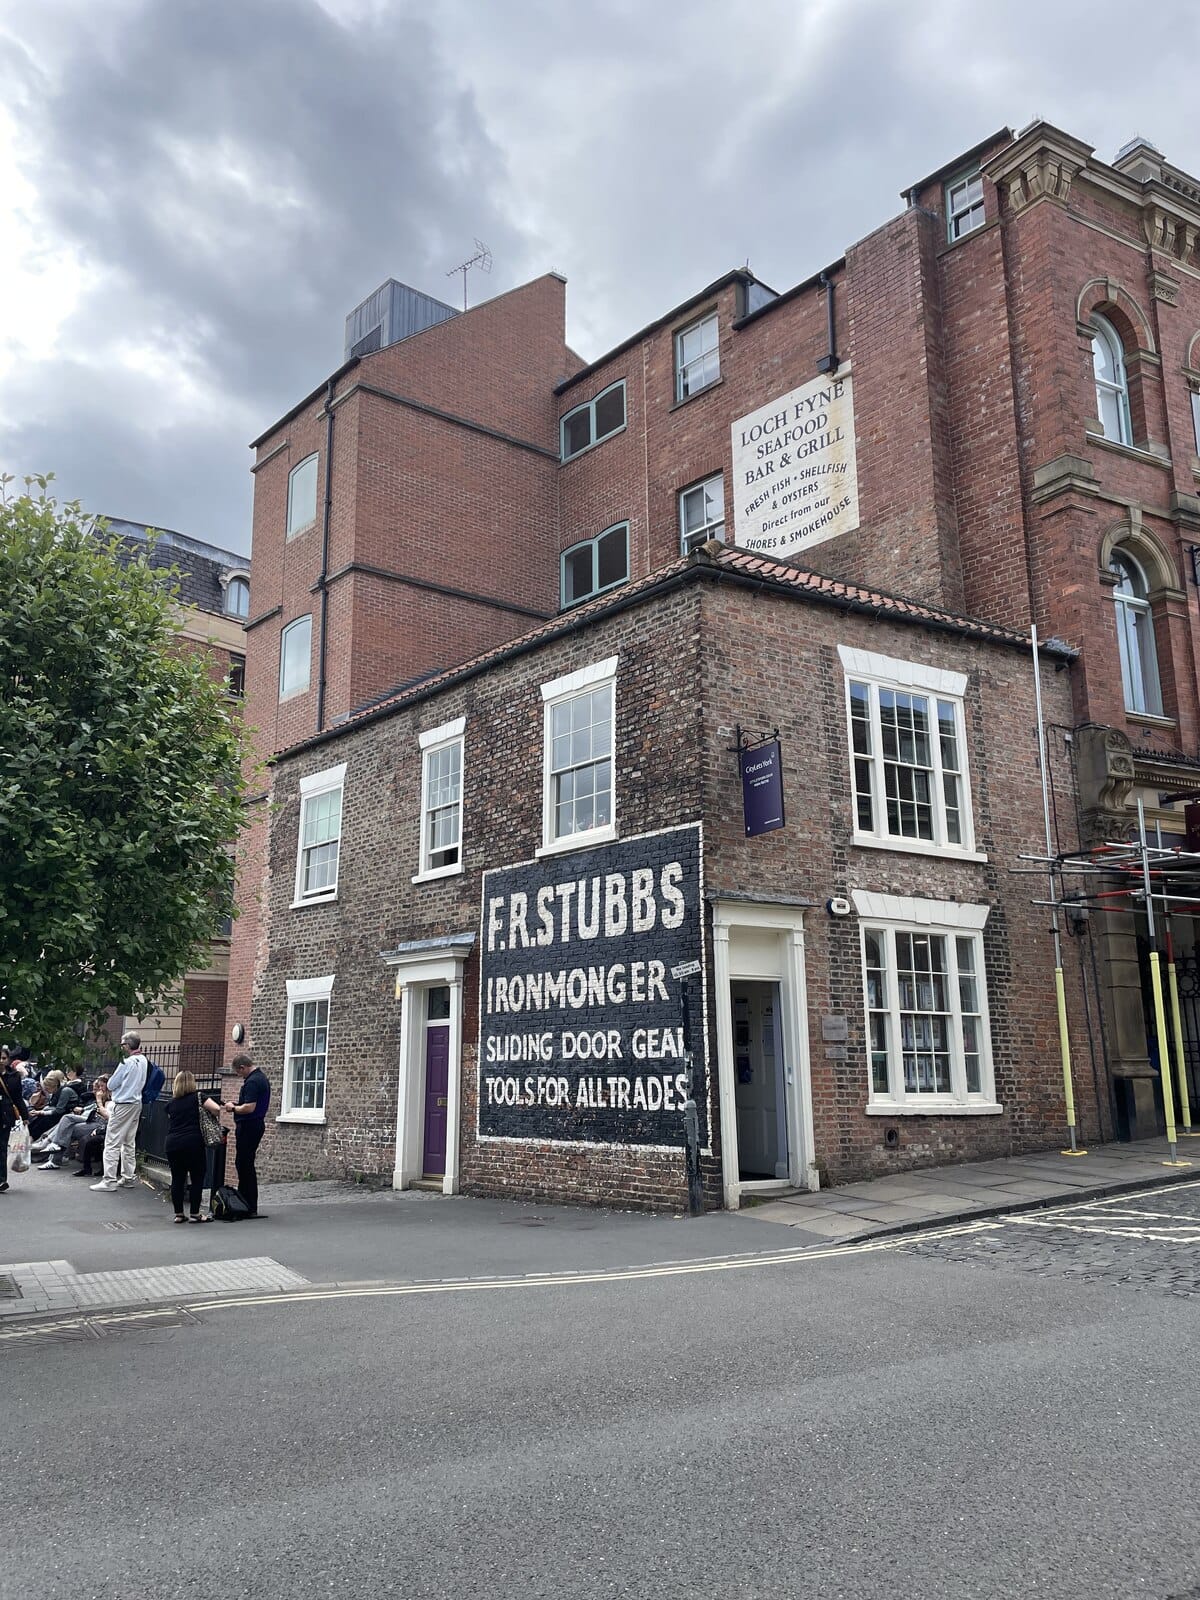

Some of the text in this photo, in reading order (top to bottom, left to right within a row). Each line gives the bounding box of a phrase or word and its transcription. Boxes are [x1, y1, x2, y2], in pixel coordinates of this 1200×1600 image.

[741, 380, 845, 448] LOCH FYNE
[756, 413, 828, 460] SEAFOOD
[745, 426, 845, 486] BAR & GRILL
[744, 462, 847, 516] FRESH FISH SHELLFISH
[771, 481, 819, 510] & OYSTERS
[745, 495, 852, 549] SHORES & SMOKEHOUSE
[762, 496, 831, 533] Direct from our
[487, 959, 670, 1014] IRONMONGER
[486, 1033, 553, 1062] SLIDING
[562, 1030, 624, 1059] DOOR
[485, 1074, 689, 1111] TOOLS FOR ALL TRADES
